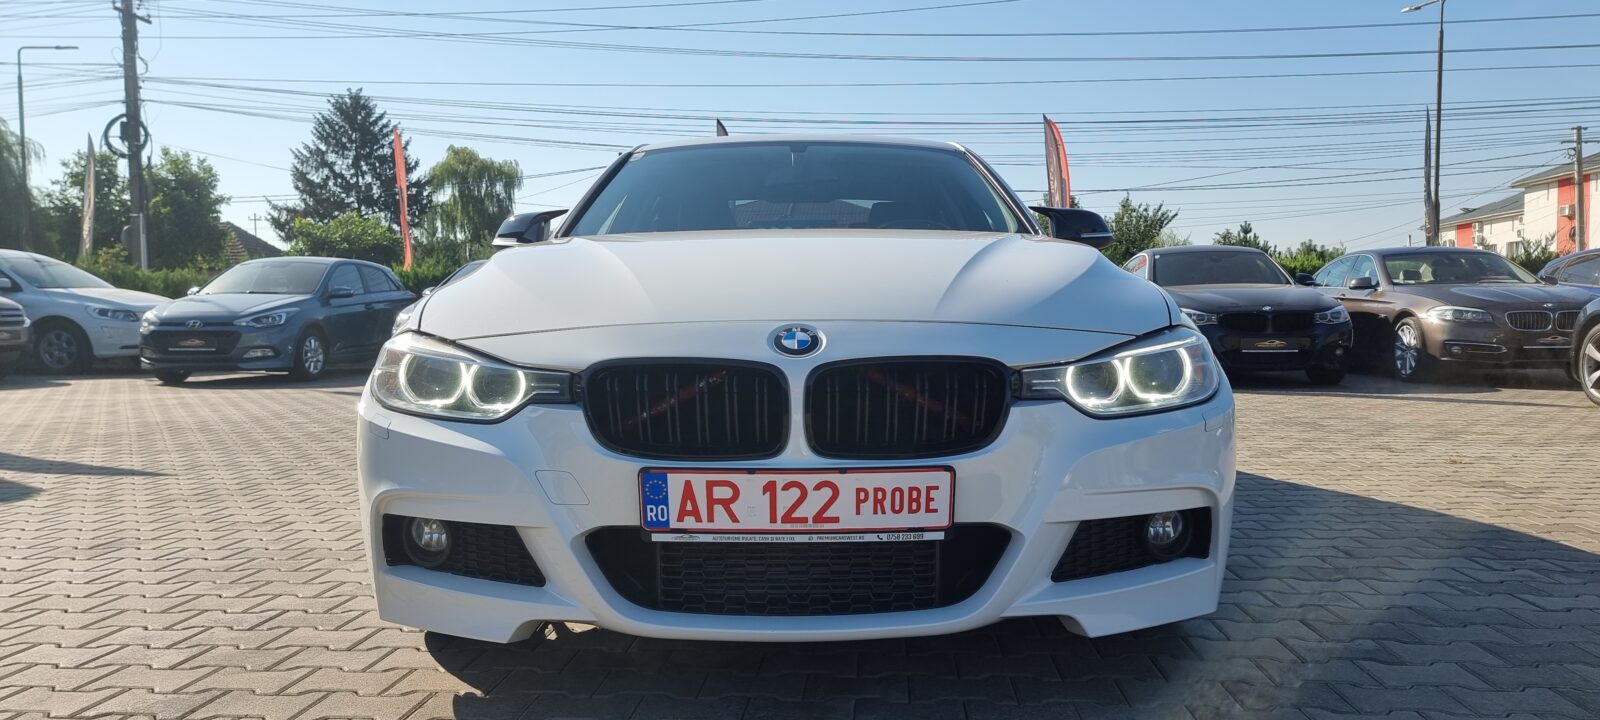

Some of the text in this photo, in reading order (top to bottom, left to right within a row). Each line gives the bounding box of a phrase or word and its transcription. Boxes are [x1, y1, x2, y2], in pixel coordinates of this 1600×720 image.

[676, 479, 939, 524] AR 122 PROBE
[646, 504, 668, 522] RO
[886, 533, 901, 541] 0758
